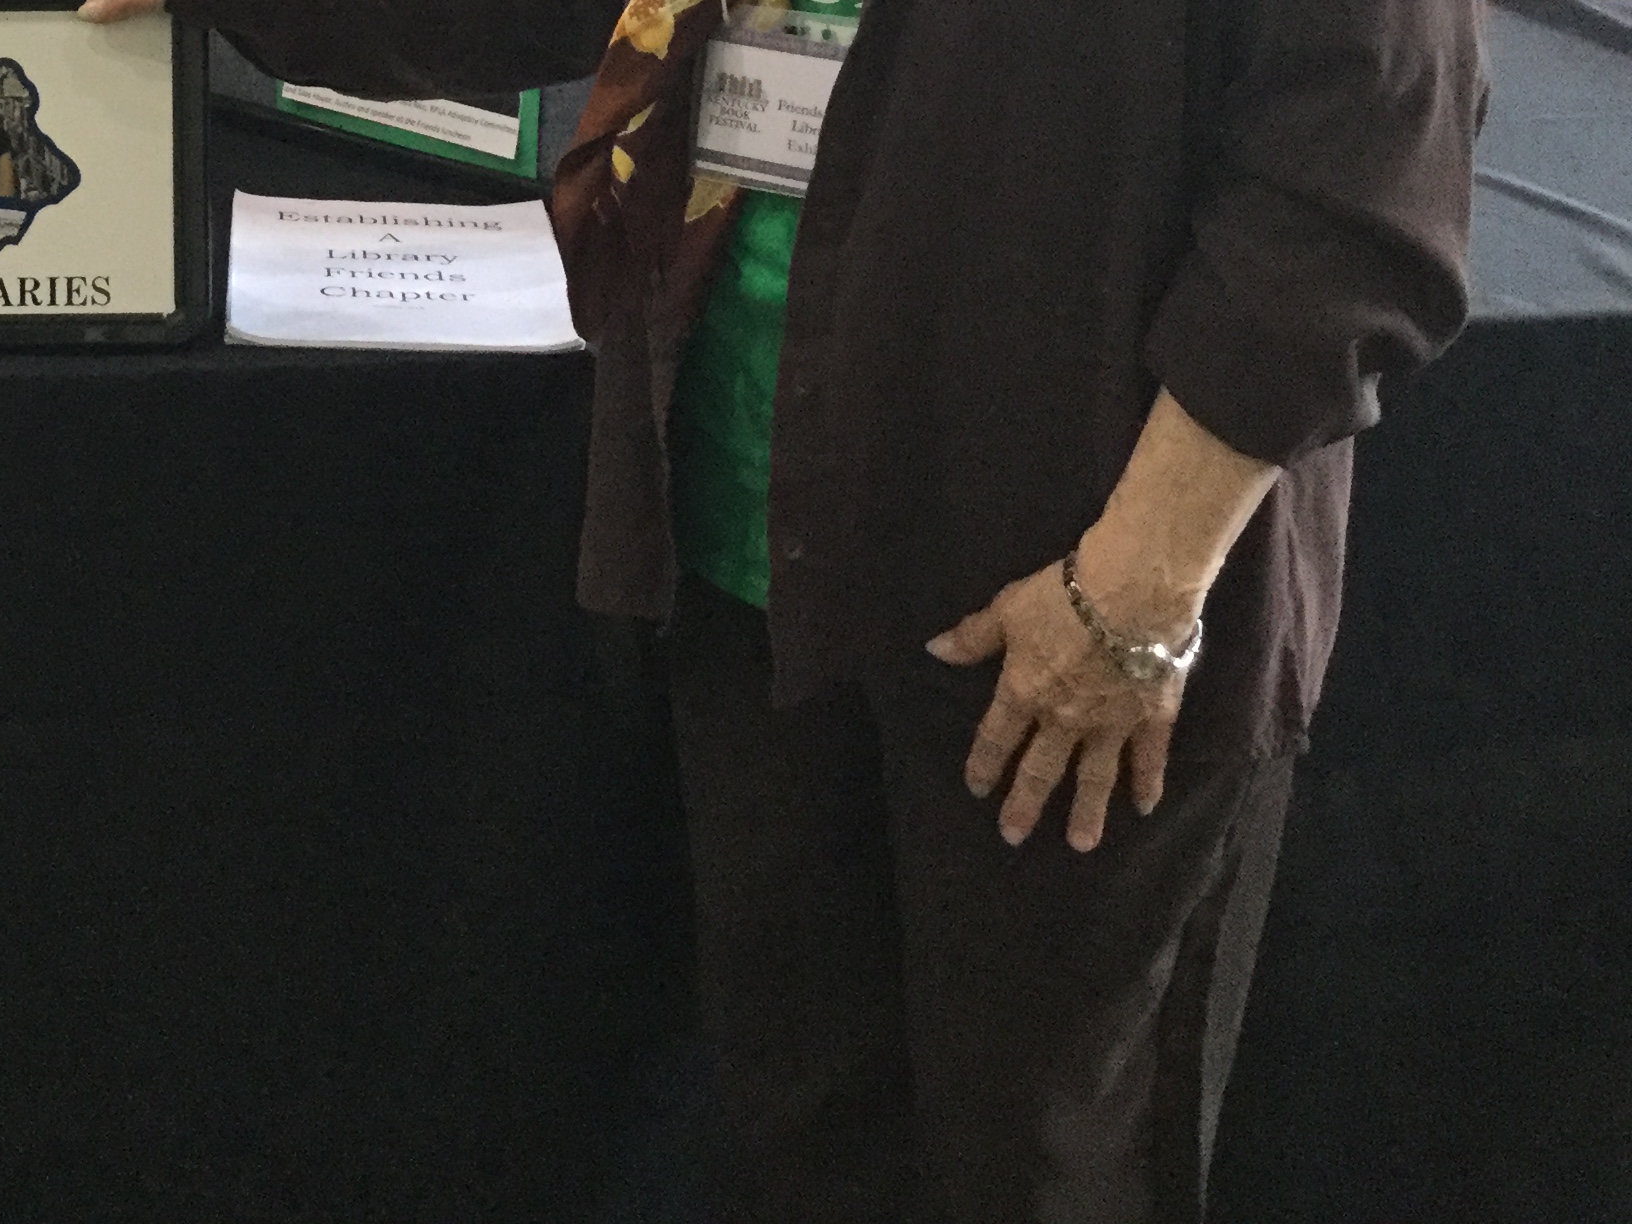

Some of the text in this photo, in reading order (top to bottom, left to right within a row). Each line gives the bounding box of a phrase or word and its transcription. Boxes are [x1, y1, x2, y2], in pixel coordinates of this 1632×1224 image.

[707, 95, 770, 113] KENTUCKY
[720, 106, 750, 120] BOOK
[791, 119, 819, 136] Libr
[278, 210, 502, 231] Establishing
[379, 232, 401, 243] A
[327, 249, 458, 265] Library
[324, 267, 466, 282] Friends
[320, 285, 476, 302] Chapter
